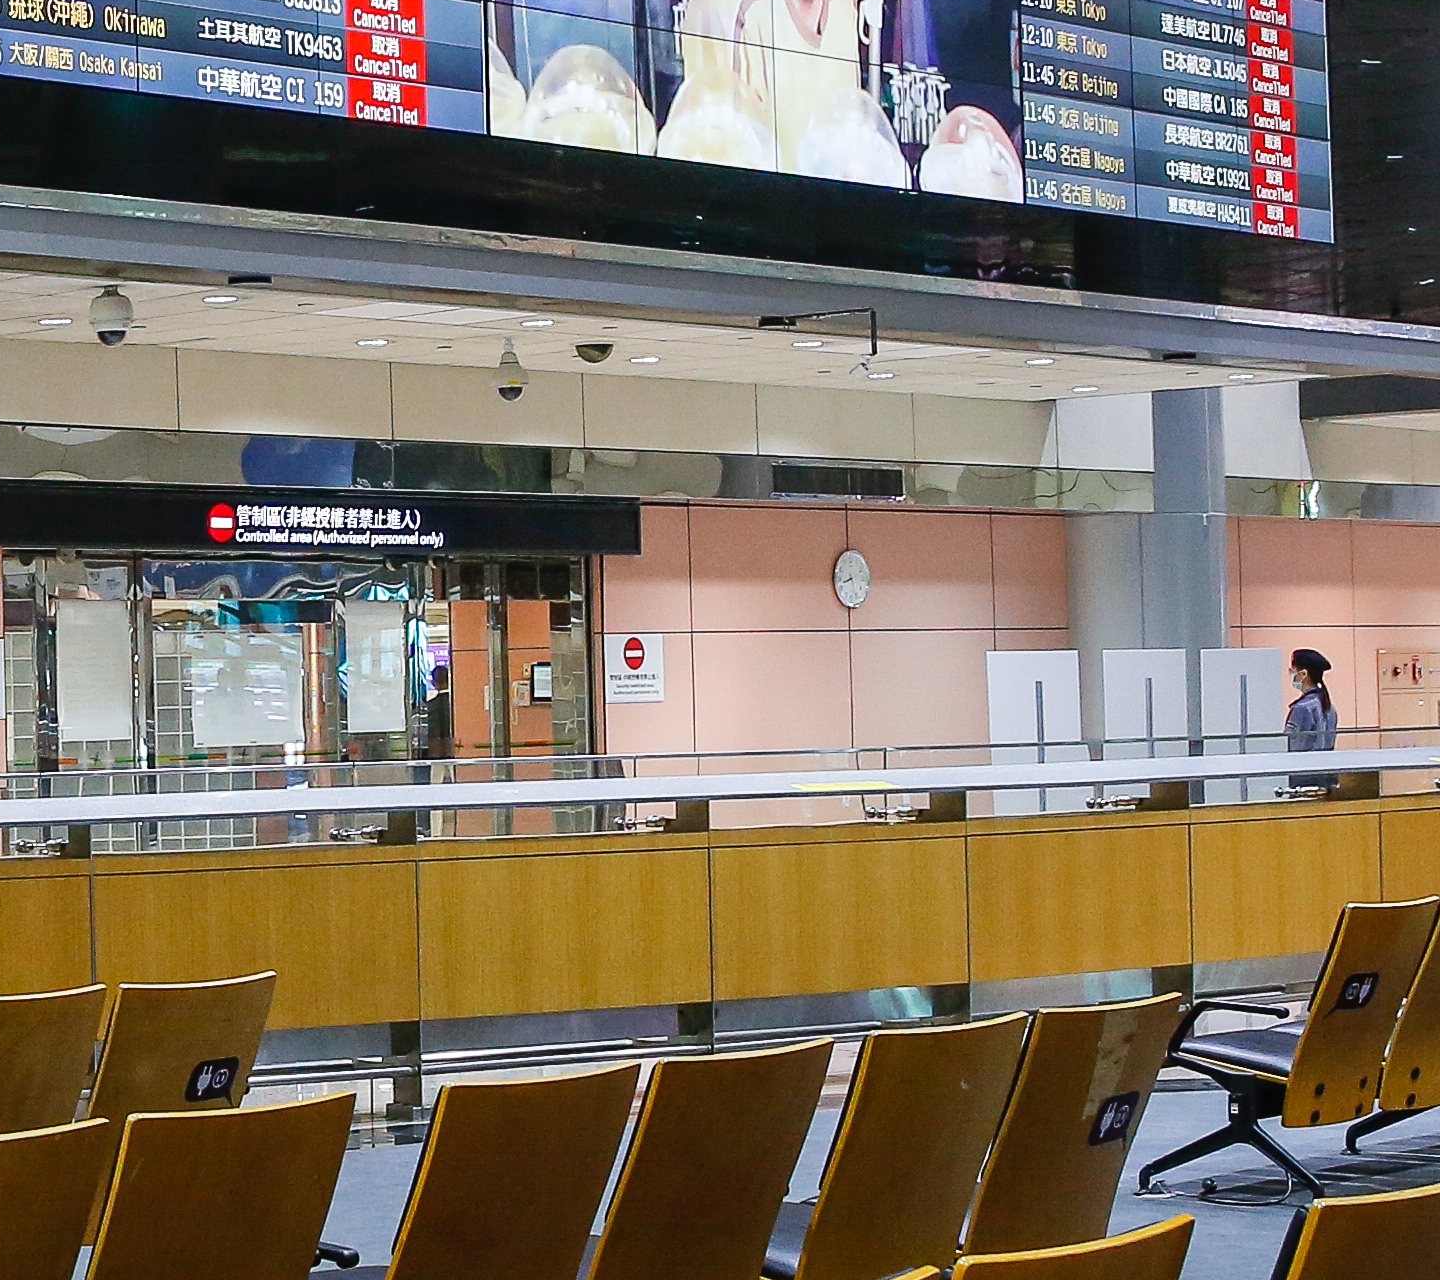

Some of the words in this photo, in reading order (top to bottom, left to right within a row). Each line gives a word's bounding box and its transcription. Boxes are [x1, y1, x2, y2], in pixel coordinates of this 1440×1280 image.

[1161, 13, 1210, 40] 達美航空
[9, 42, 74, 70] 大阪/關西
[80, 52, 114, 74] Osaka
[121, 57, 161, 80] Kansai
[196, 66, 282, 100] 中華航空
[287, 78, 304, 102] CI
[315, 82, 343, 107] 159
[373, 81, 400, 103] 取消
[1023, 62, 1054, 85] 11:45
[1058, 68, 1078, 91] 北京
[1083, 73, 1117, 98] Beijing
[1214, 96, 1226, 114] CA
[356, 101, 418, 125] Cancelled
[236, 529, 289, 543] Controlled
[290, 532, 312, 543] area
[313, 531, 369, 545] (Authorized
[371, 533, 418, 548] personnel
[420, 532, 443, 548] only)
